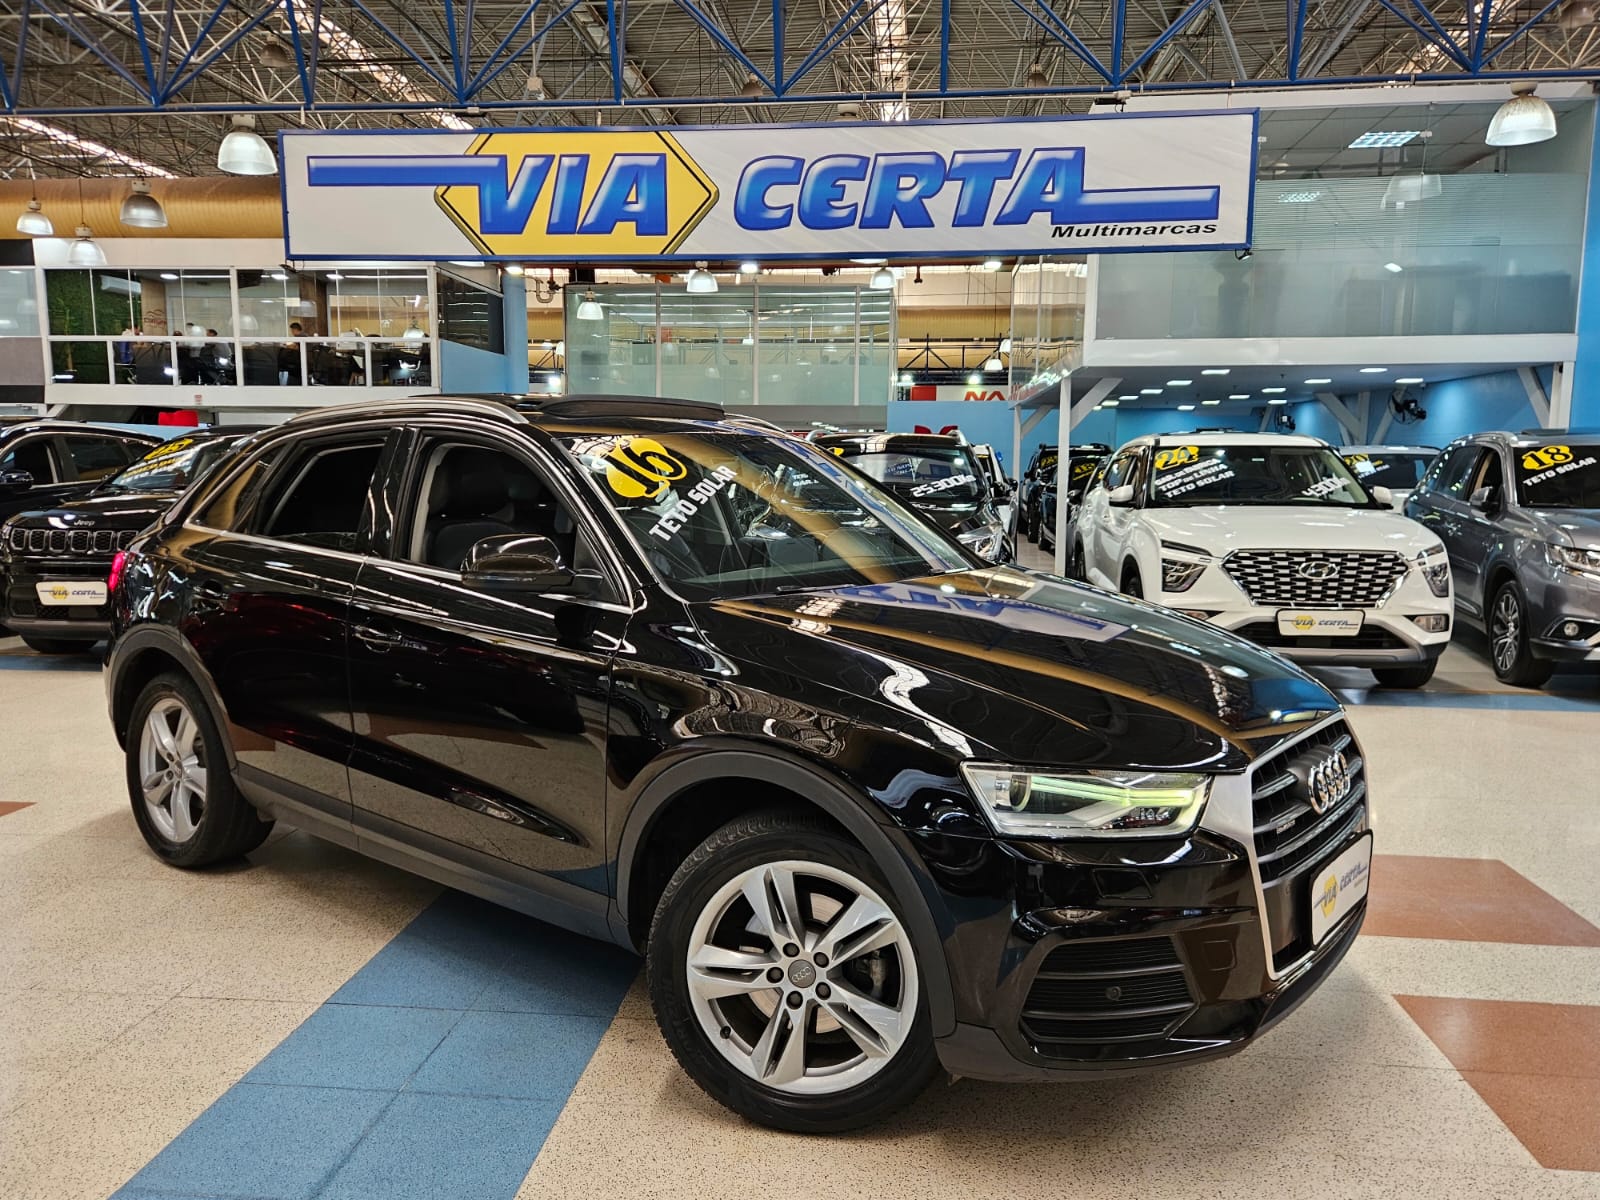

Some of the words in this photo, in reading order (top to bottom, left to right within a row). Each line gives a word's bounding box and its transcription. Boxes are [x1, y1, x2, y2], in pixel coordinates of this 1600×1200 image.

[478, 153, 668, 236] VIA
[734, 146, 1086, 231] CERTA
[1051, 223, 1218, 239] Multimarcas
[606, 437, 688, 498] 16
[1155, 446, 1199, 470] 24
[1522, 446, 1573, 470] 18
[1159, 478, 1183, 491] TOP
[1165, 483, 1196, 498] TETO
[1196, 470, 1235, 487] SOLAR
[1523, 470, 1556, 486] TETO
[1556, 457, 1597, 474] SOLAR
[649, 499, 698, 541] TETO
[688, 465, 738, 504] SOLAR
[74, 518, 95, 528] Jeep
